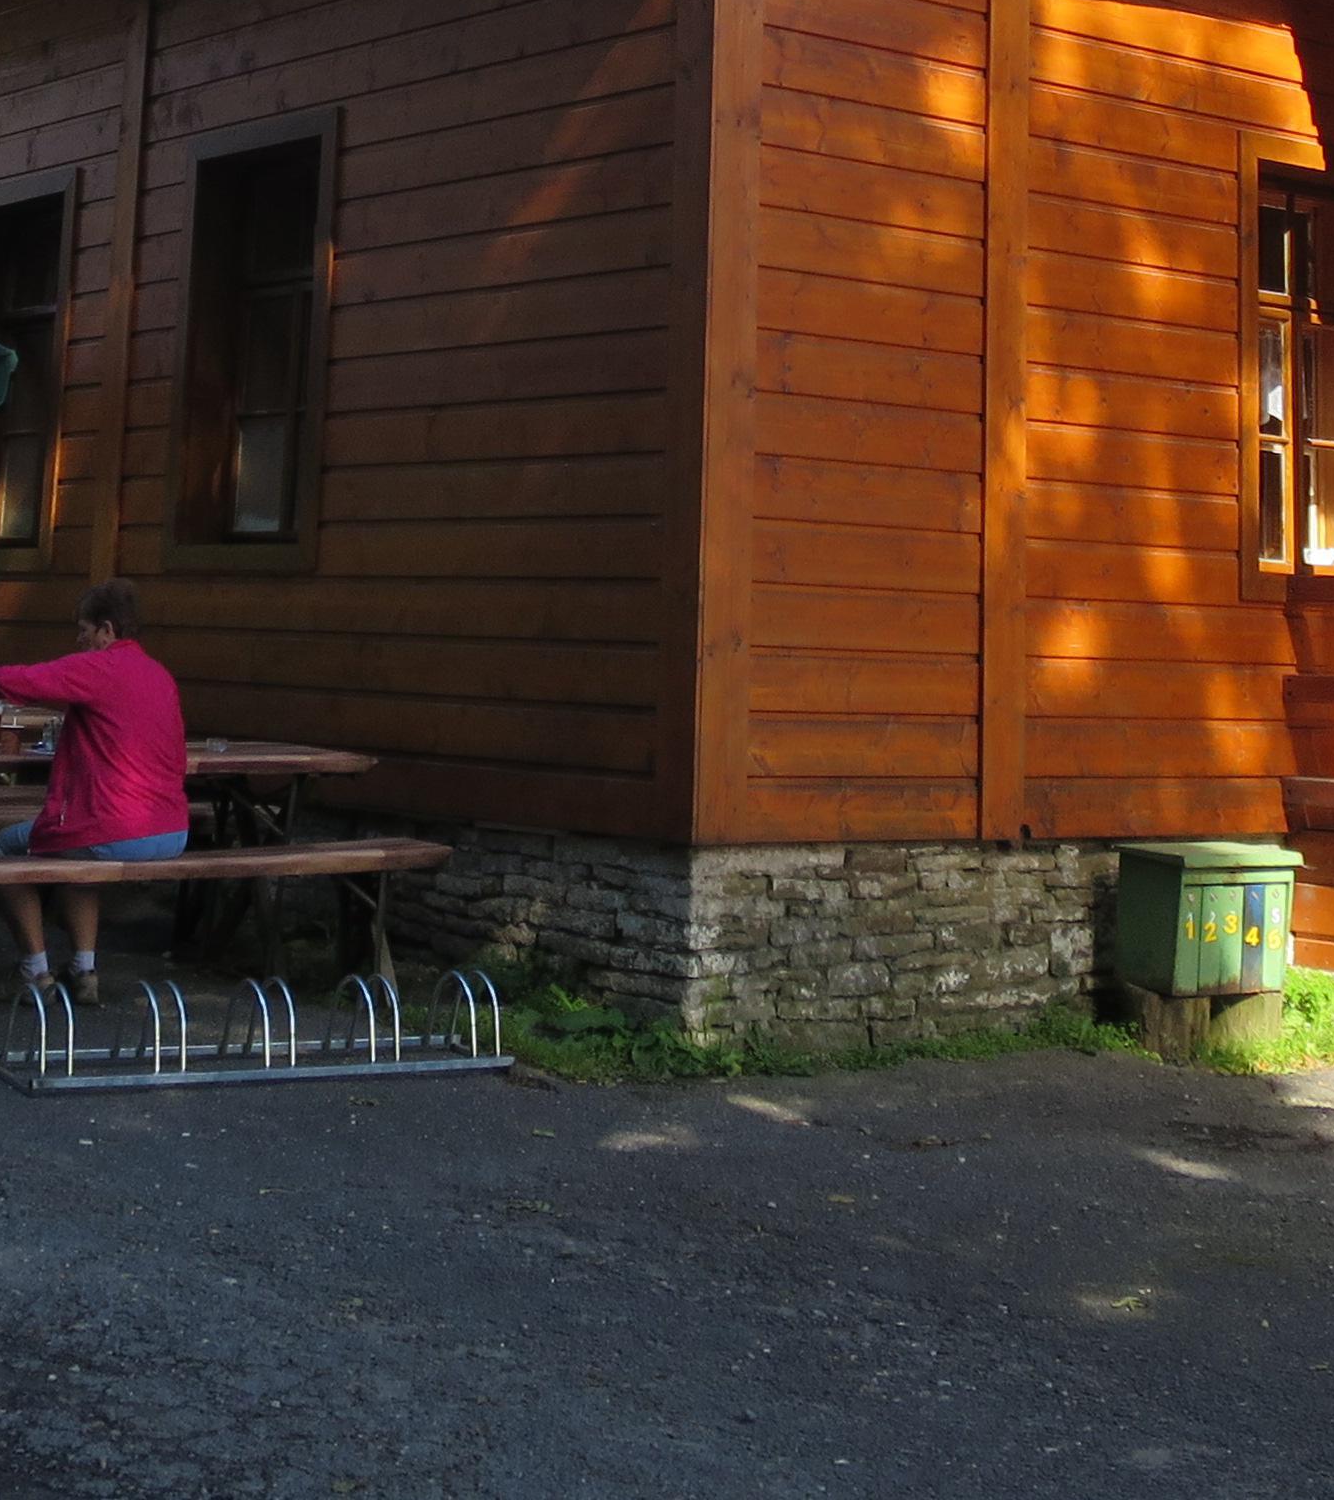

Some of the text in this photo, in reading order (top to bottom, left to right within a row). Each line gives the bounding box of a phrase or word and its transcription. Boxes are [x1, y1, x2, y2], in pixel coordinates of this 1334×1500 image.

[1185, 921, 1195, 940] 1
[1204, 922, 1217, 942] 2
[1223, 914, 1238, 934] 3
[1245, 926, 1260, 946] 4
